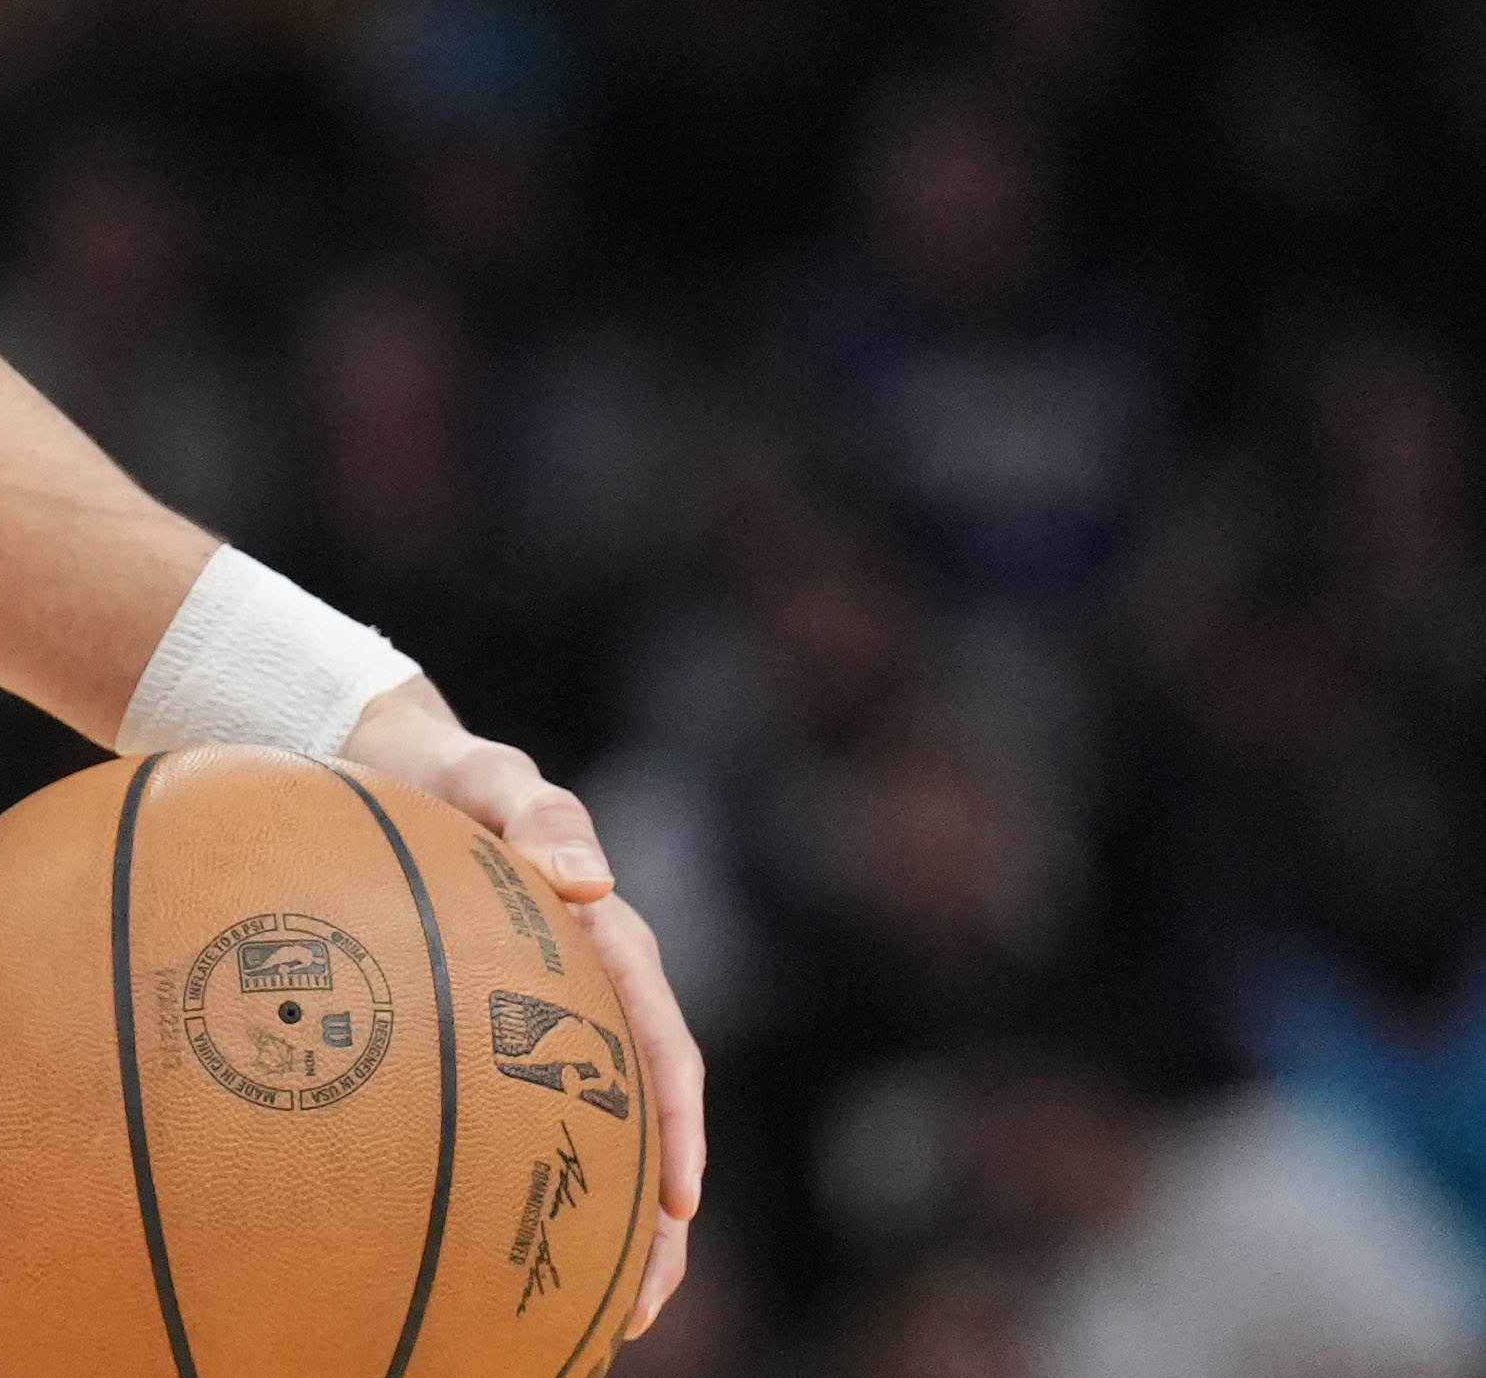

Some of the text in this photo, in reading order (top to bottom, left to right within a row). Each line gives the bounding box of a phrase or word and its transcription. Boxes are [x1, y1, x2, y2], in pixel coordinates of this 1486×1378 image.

[188, 950, 219, 1001] INFLATE
[213, 936, 232, 952] TO
[241, 919, 266, 935] PSI
[193, 1033, 277, 1106] MADE IN CHINA
[310, 1019, 390, 1104] DESIGNED IN USA
[509, 1159, 552, 1266] COMMISSIONER
